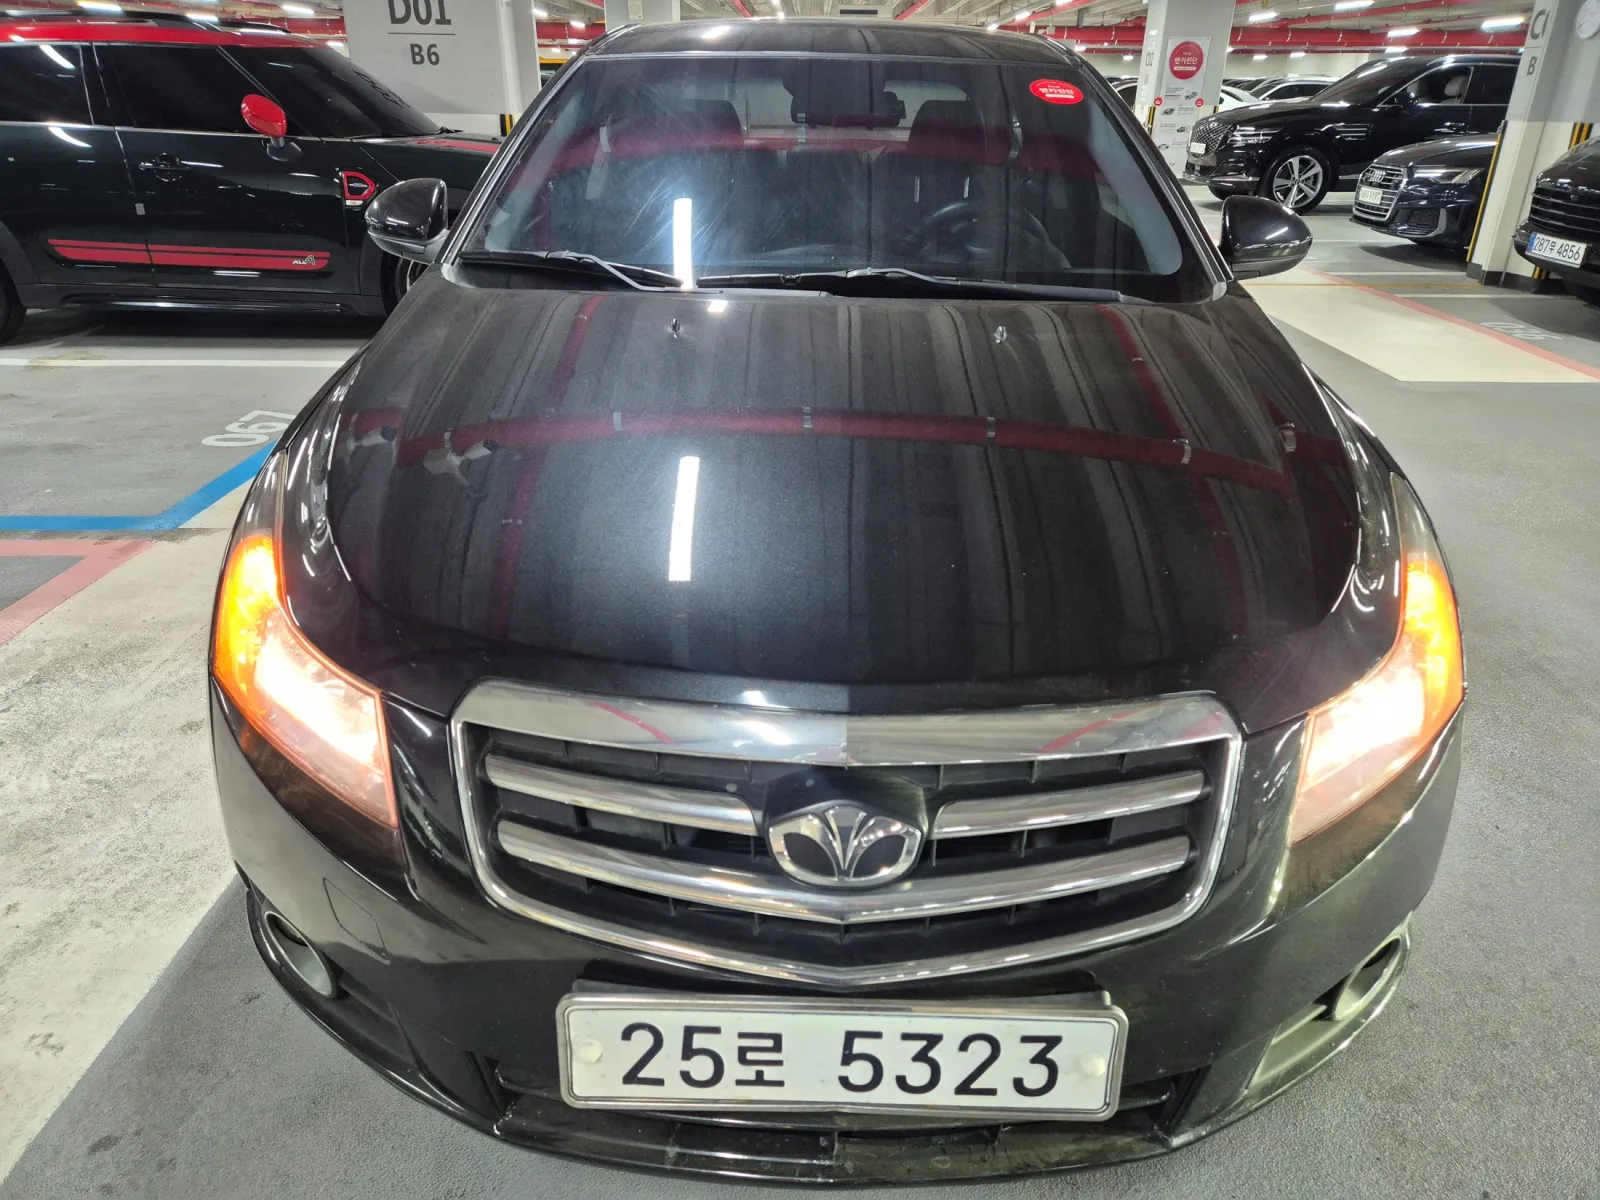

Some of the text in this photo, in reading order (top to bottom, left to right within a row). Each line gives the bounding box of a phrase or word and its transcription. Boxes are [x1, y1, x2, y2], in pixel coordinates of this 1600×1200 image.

[388, 0, 452, 26] D01
[410, 43, 440, 66] B6
[1556, 243, 1581, 261] 4856
[201, 409, 297, 447] 067
[620, 1022, 1064, 1098] 25로 5323
